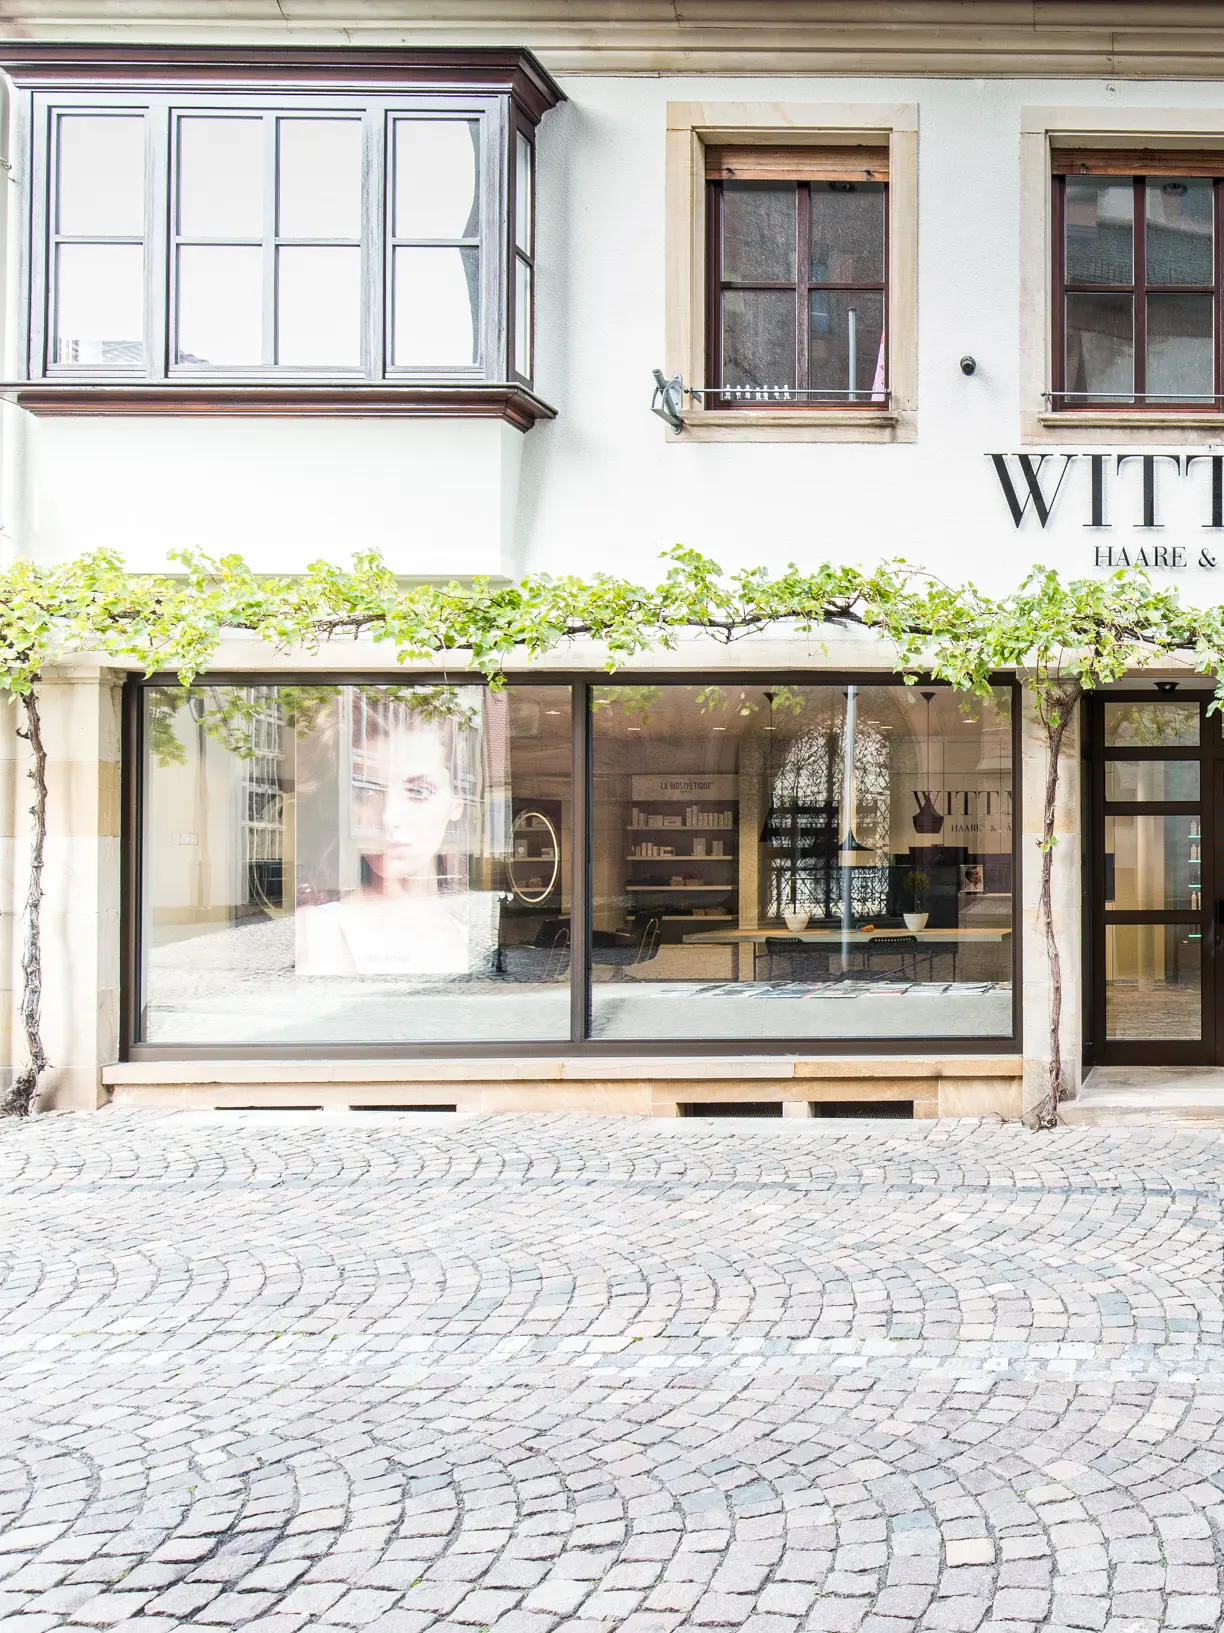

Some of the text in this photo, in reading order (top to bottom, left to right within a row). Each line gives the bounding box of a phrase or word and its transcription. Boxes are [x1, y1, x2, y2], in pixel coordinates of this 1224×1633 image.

[1093, 545, 1188, 568] HAARE
[1197, 547, 1217, 568] &
[660, 781, 669, 790] LA
[951, 824, 983, 832] HAARE
